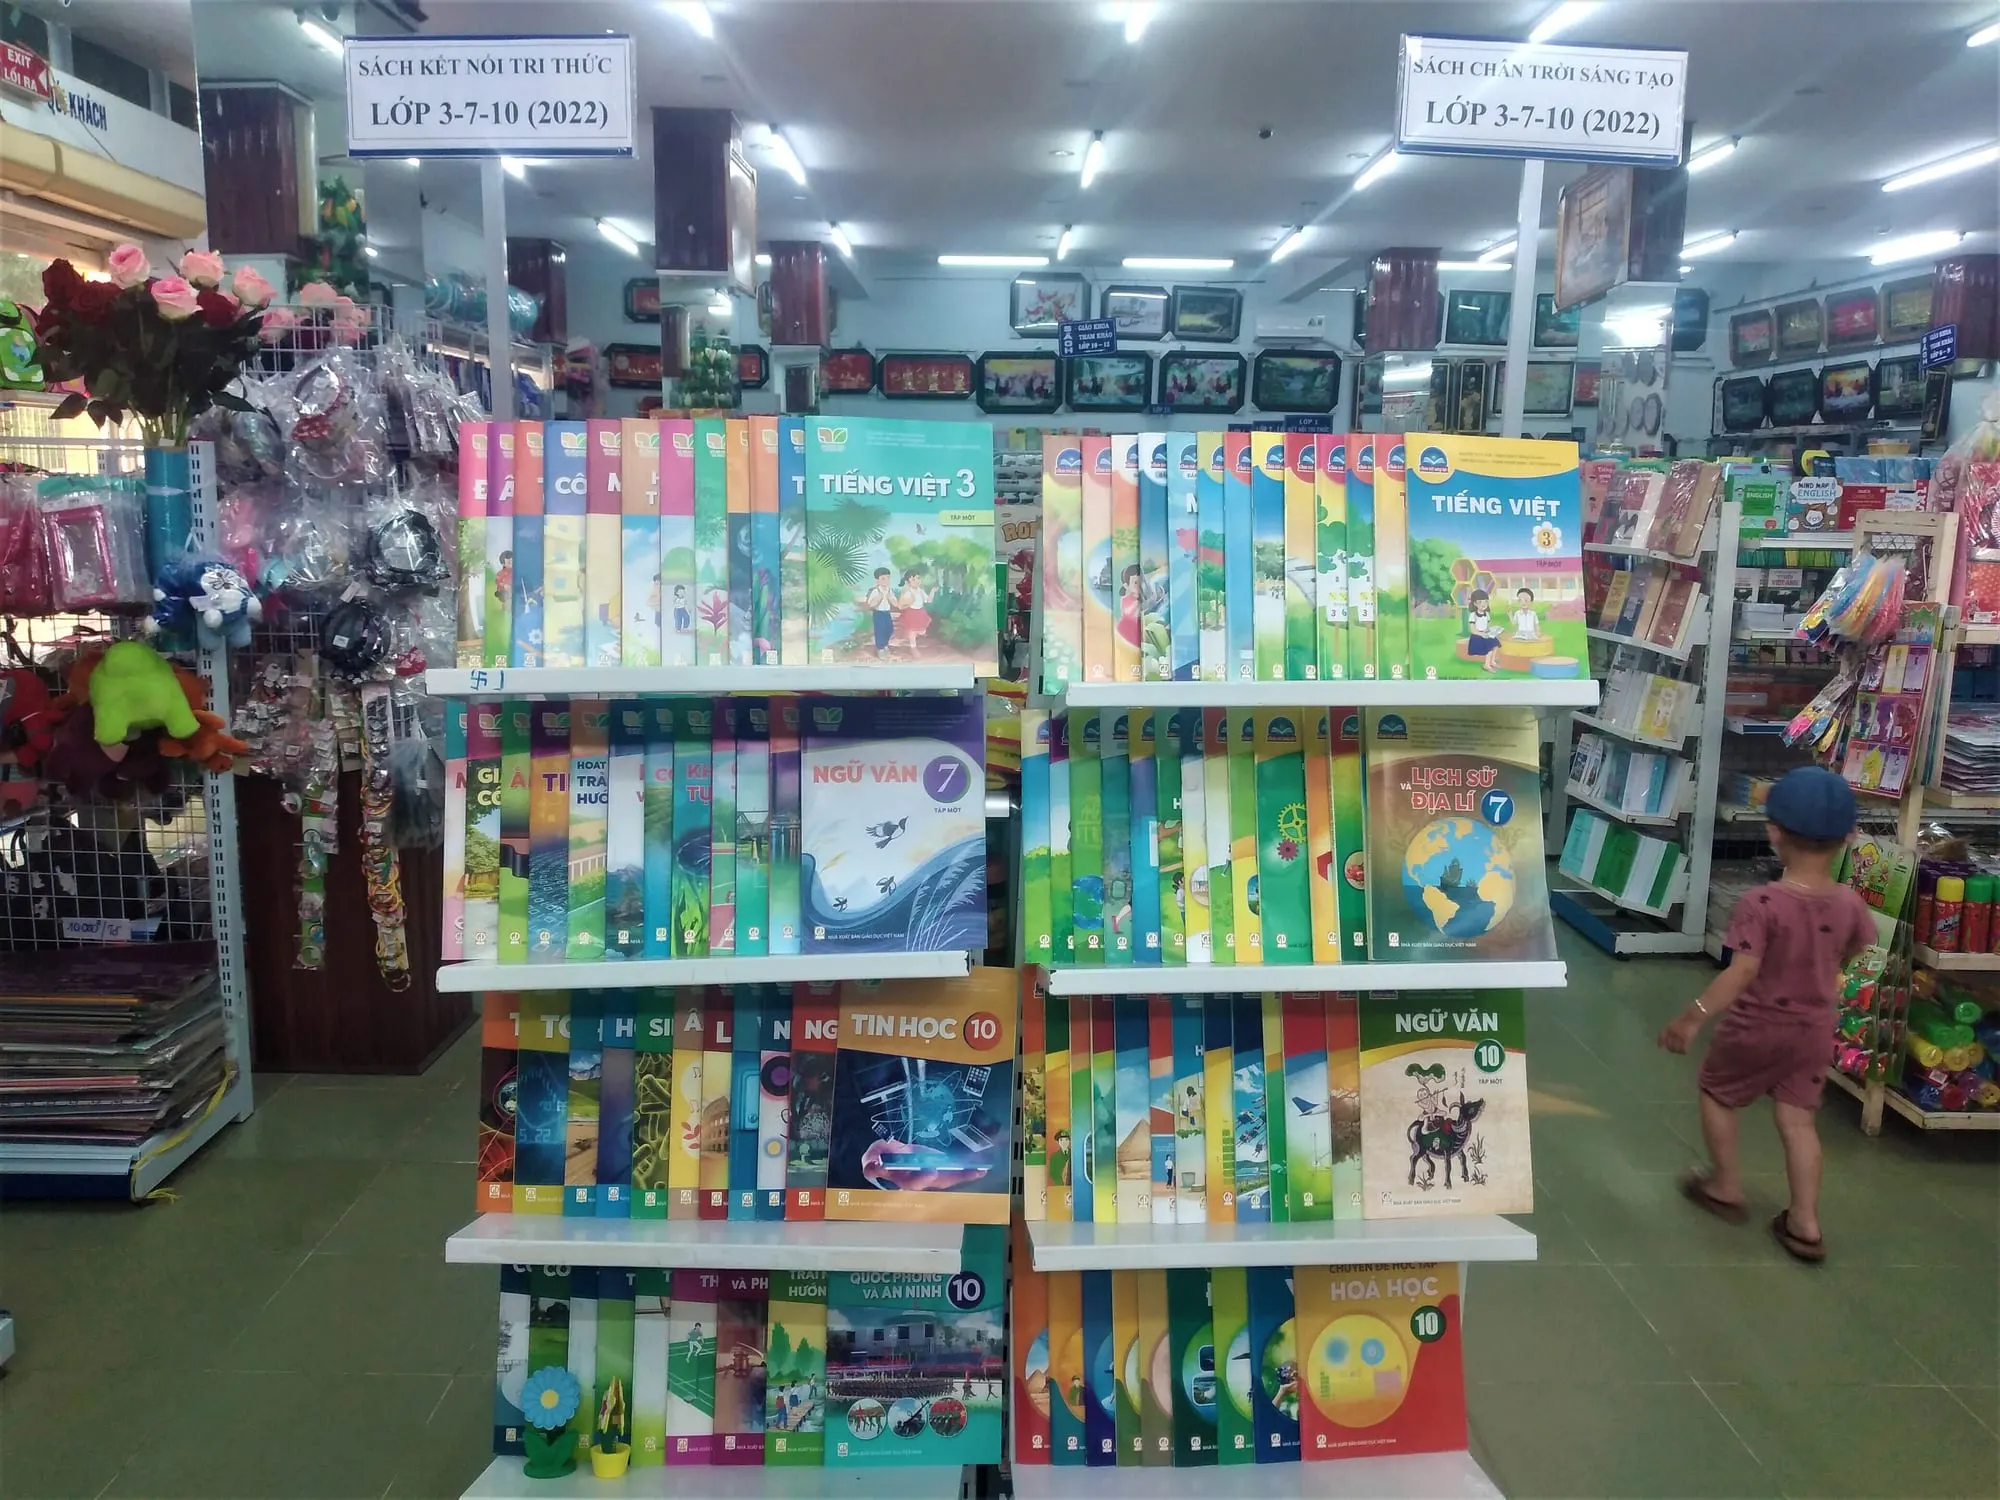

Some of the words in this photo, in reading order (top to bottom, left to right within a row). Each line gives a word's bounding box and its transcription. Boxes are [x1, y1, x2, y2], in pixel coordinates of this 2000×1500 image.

[8, 49, 32, 69] EXIT
[359, 56, 412, 76] SÁCH
[420, 54, 461, 75] KẾT
[467, 53, 502, 74] NỐI
[509, 57, 544, 74] TRI
[551, 53, 612, 74] THỨC
[4, 68, 21, 85] LỐI
[23, 77, 38, 91] RA
[1413, 56, 1464, 75] SÁCH
[1470, 58, 1524, 78] CHÂN
[1529, 62, 1574, 81] TRỜI
[1580, 65, 1631, 84] SÁNG
[1636, 71, 1674, 89] TẠO
[69, 91, 108, 131] KHÁCH
[371, 96, 431, 126] LỚP
[439, 101, 519, 125] 3-7-10
[527, 101, 608, 129] (2022)
[1426, 95, 1487, 125] LỚP
[1494, 104, 1574, 130] 3-7-10
[1582, 109, 1660, 141] (2022)
[555, 473, 587, 495] CÔ
[819, 468, 894, 496] TIẾNG
[898, 472, 951, 502] VIỆT
[956, 468, 977, 498] 3
[1797, 489, 1836, 497] ENGLISH
[1432, 490, 1502, 515] TIẾNG
[1509, 496, 1561, 521] VIỆT
[1543, 531, 1551, 546] 3
[813, 760, 865, 784] NGỮ
[870, 761, 918, 784] VĂN
[937, 763, 960, 793] 7
[1411, 766, 1461, 790] LỊCH
[1466, 764, 1498, 788] SỬ
[1400, 782, 1412, 791] VÀ
[1411, 792, 1450, 815] ĐỊA
[1455, 790, 1475, 811] LÍ
[1489, 796, 1509, 823] 7
[615, 1017, 634, 1038] H
[683, 1007, 705, 1032] Â
[773, 1020, 791, 1040] N
[804, 1020, 838, 1040] NG
[851, 1013, 894, 1038] TIN
[899, 1017, 957, 1043] HỌC
[970, 1019, 996, 1040] 10
[1395, 1009, 1449, 1033] NGỮ
[1452, 1008, 1499, 1032] VĂN
[716, 1020, 732, 1043] L
[1478, 1045, 1500, 1067] 10
[731, 1277, 747, 1290] VÀ
[751, 1277, 769, 1290] PH
[881, 1285, 903, 1298] AN
[905, 1285, 942, 1297] NINH
[952, 1278, 981, 1301] 10
[1330, 1276, 1380, 1301] HOÁ
[1387, 1277, 1439, 1302] HỌC
[1415, 1312, 1439, 1336] 10
